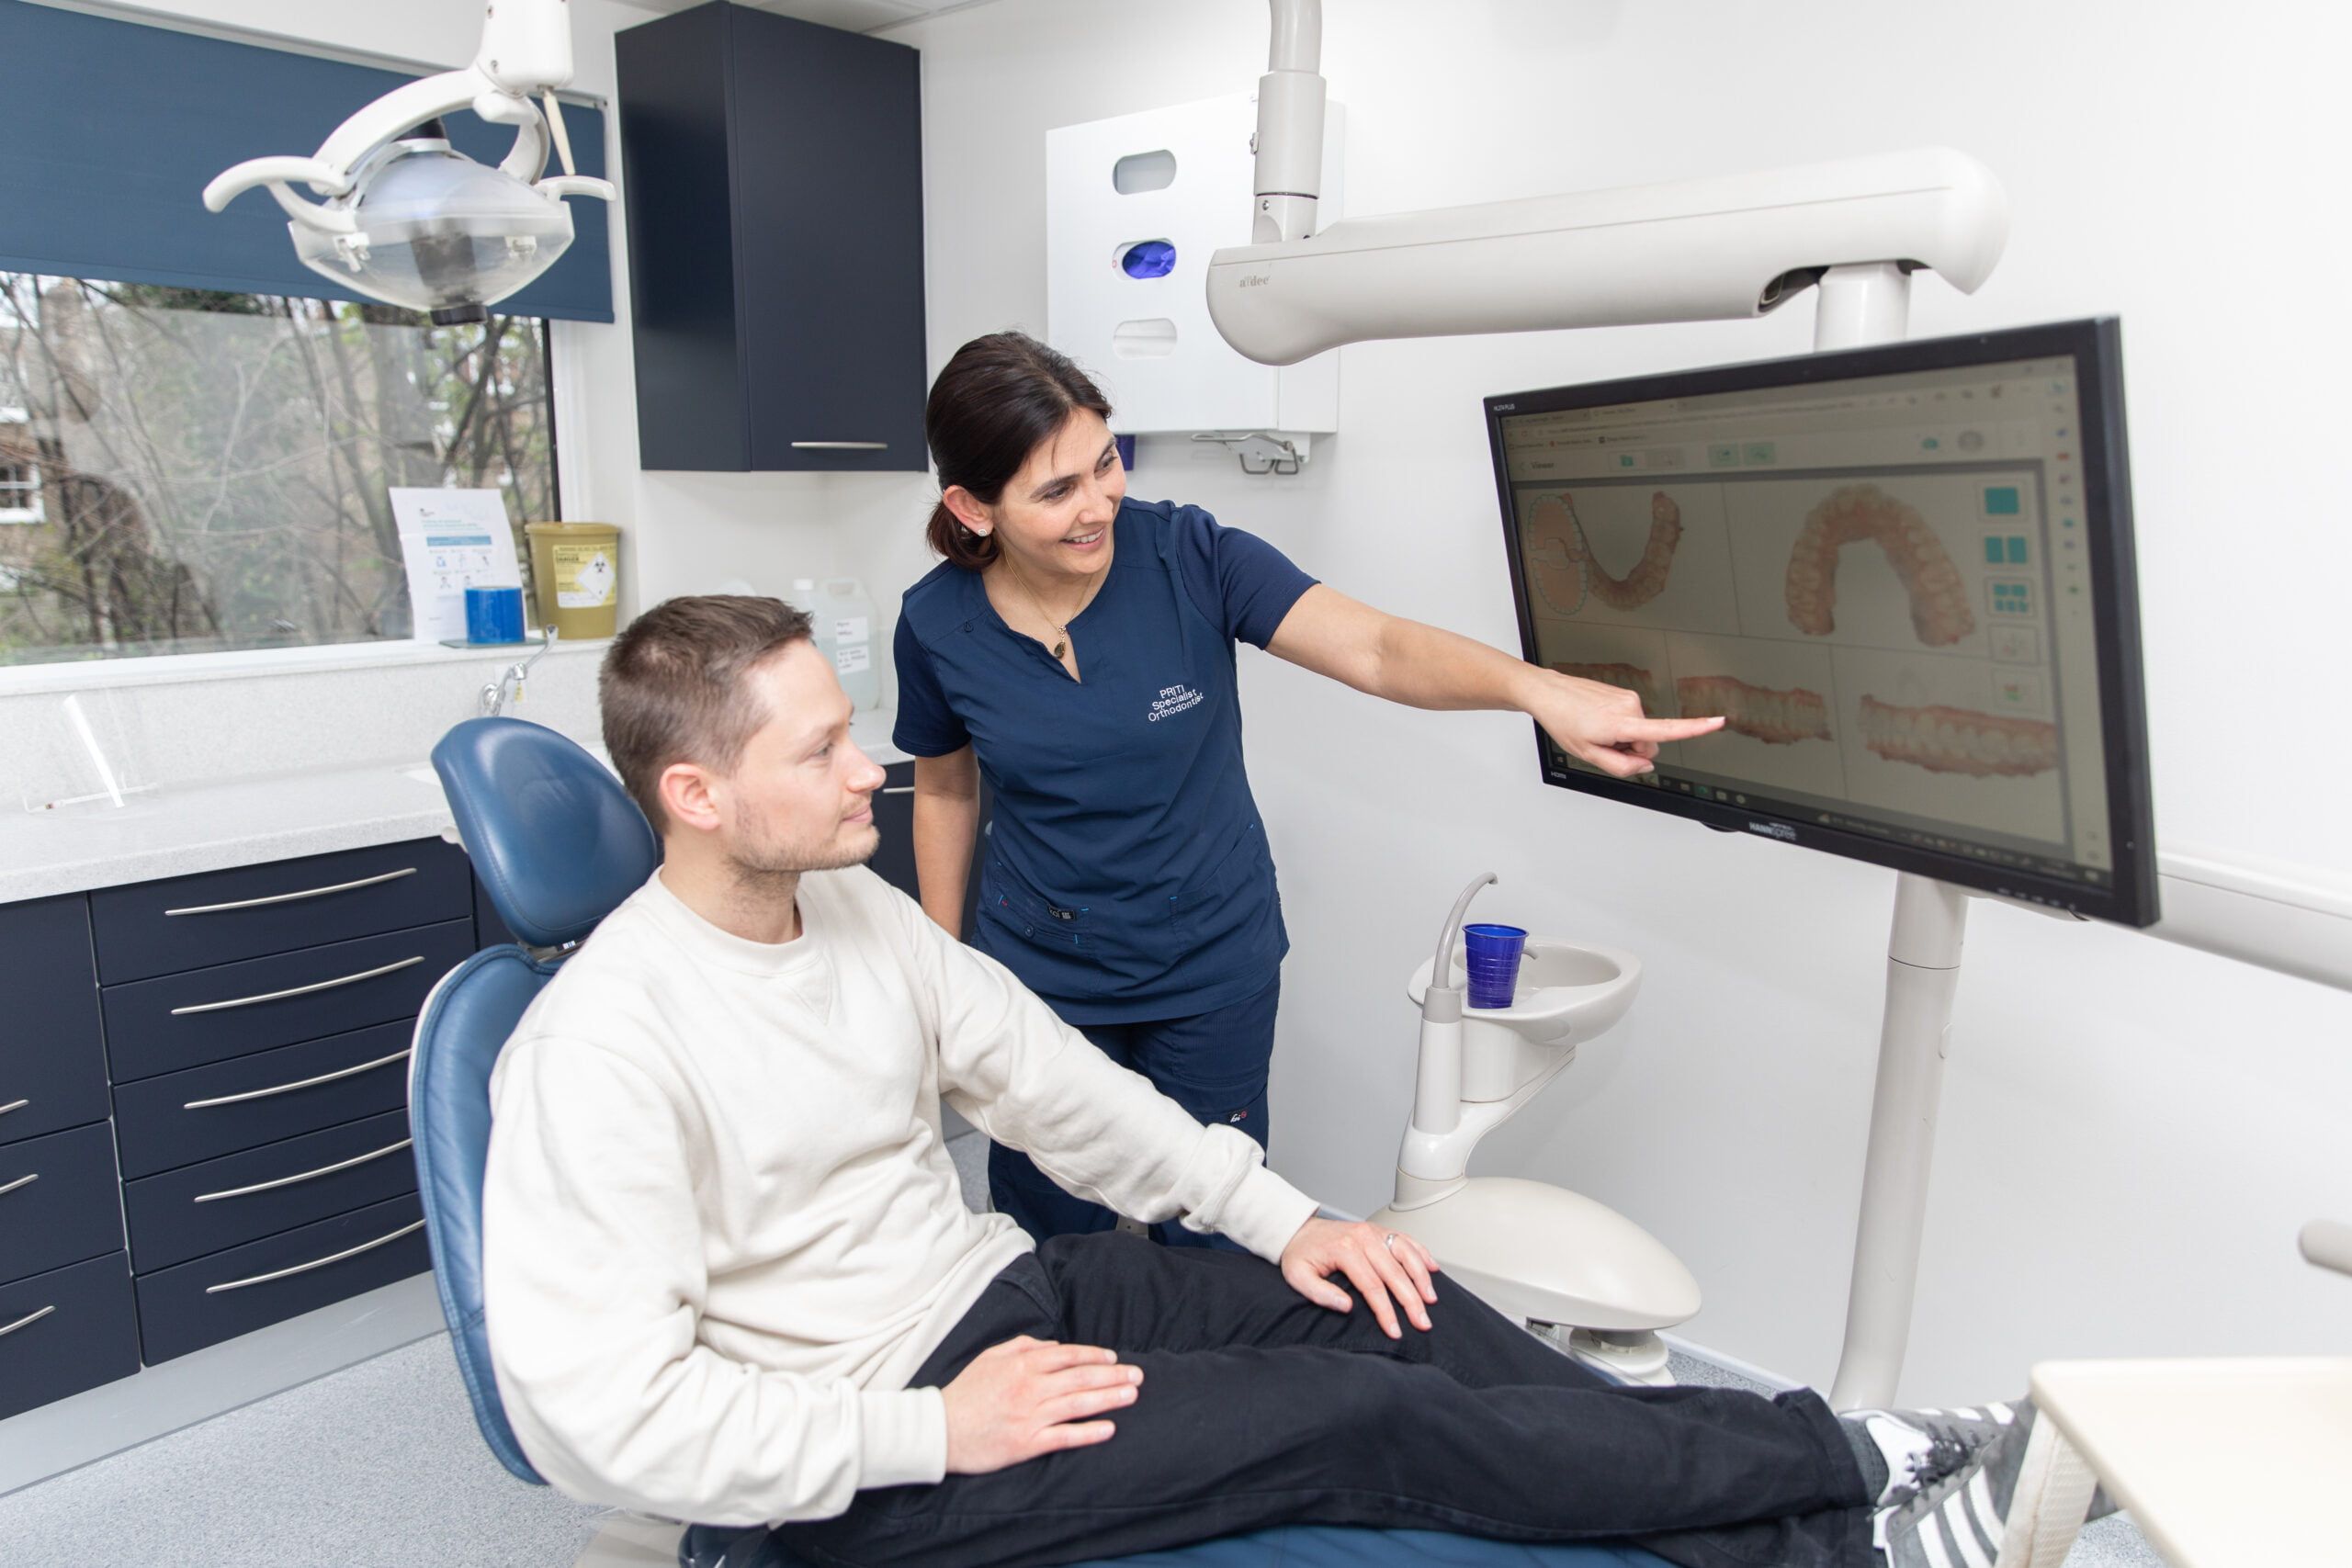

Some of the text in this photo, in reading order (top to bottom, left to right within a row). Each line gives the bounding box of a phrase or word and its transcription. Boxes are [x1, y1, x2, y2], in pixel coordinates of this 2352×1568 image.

[1152, 689, 1197, 710] Specialist
[1159, 684, 1185, 699] PRITI
[1148, 692, 1204, 722] Orthodontist
